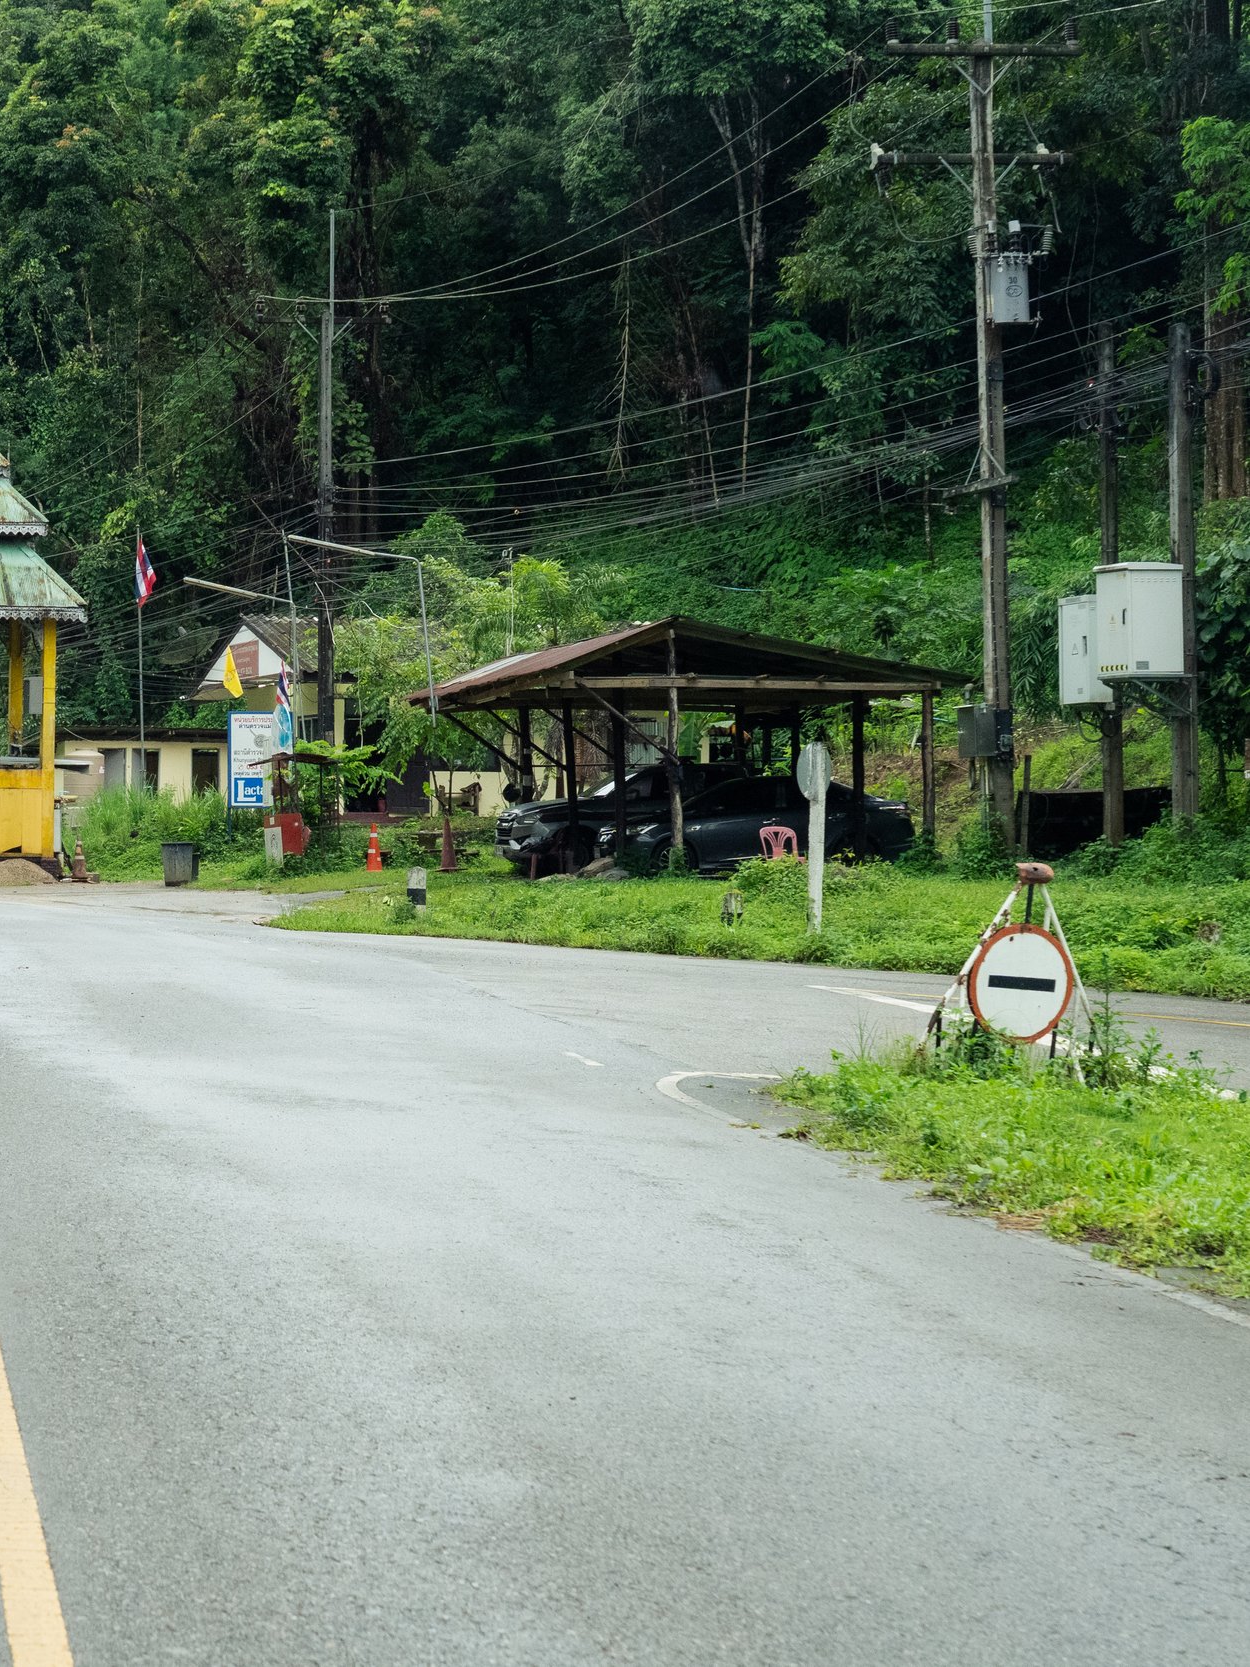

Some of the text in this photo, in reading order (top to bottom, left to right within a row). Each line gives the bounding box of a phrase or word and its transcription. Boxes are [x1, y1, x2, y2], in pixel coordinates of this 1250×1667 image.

[234, 715, 273, 723] หน่วยบริการประ
